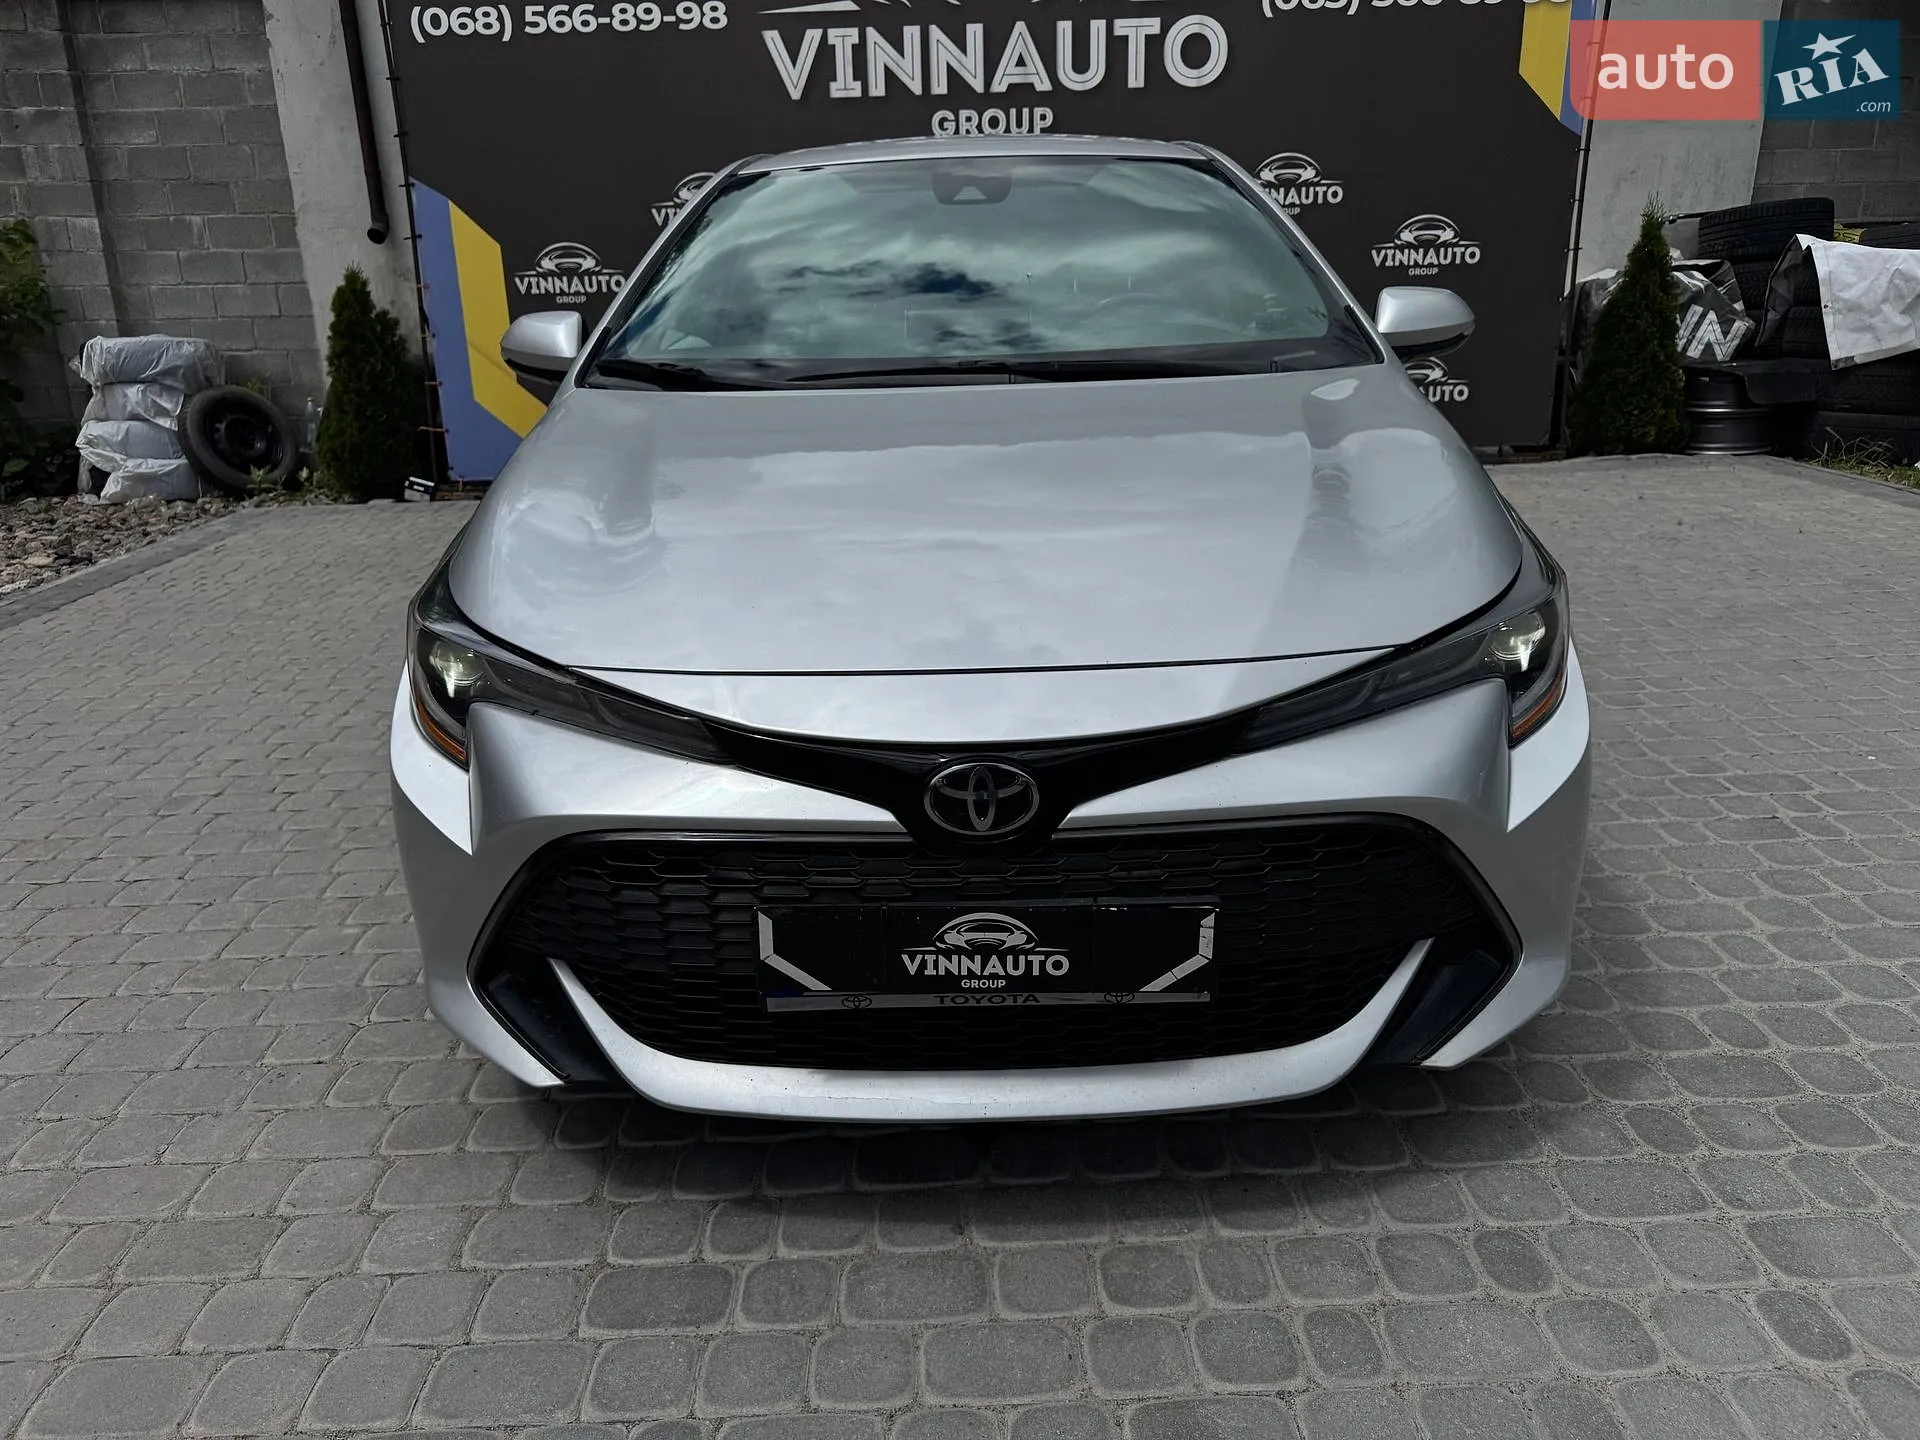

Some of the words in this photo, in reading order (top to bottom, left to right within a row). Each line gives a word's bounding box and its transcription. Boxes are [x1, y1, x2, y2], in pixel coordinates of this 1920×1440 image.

[410, 4, 513, 44] (068)
[524, 0, 729, 34] 566-89-98
[761, 14, 1229, 100] VINNAUTO
[931, 107, 1054, 137] GROUP
[1371, 246, 1481, 267] VINNAUTO
[1408, 266, 1439, 276] GROUP
[514, 274, 626, 295] VINNAUTO
[555, 295, 587, 304] GROUP
[901, 954, 1070, 976] VINNAUTO
[961, 979, 1006, 989] GROUP
[933, 993, 1041, 1005] TOYOTA
